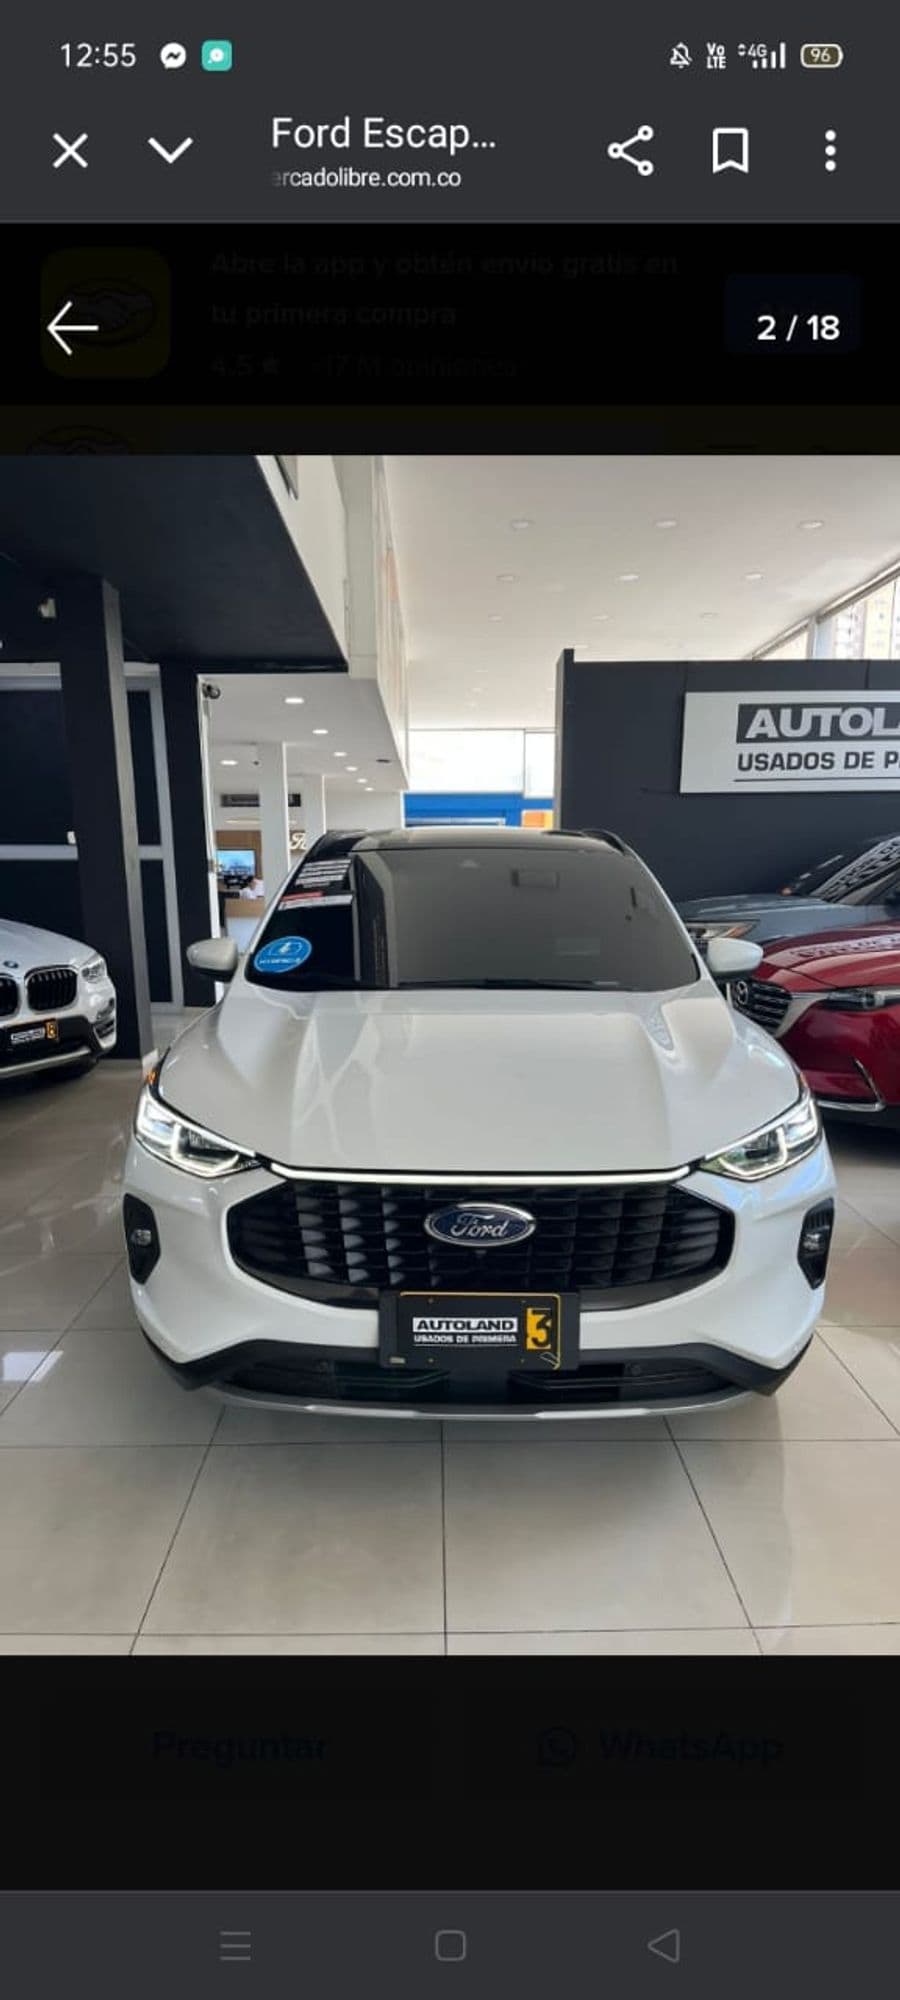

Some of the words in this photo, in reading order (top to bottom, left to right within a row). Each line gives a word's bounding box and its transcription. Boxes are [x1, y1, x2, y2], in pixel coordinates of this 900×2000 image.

[745, 706, 900, 739] AUTOL
[737, 752, 835, 771] USADOS
[843, 751, 875, 769] DE
[884, 751, 900, 769] P
[451, 1213, 509, 1238] Ford
[417, 1319, 515, 1331] AUTOLAND
[530, 1309, 552, 1348] 3
[456, 1334, 470, 1343] DE
